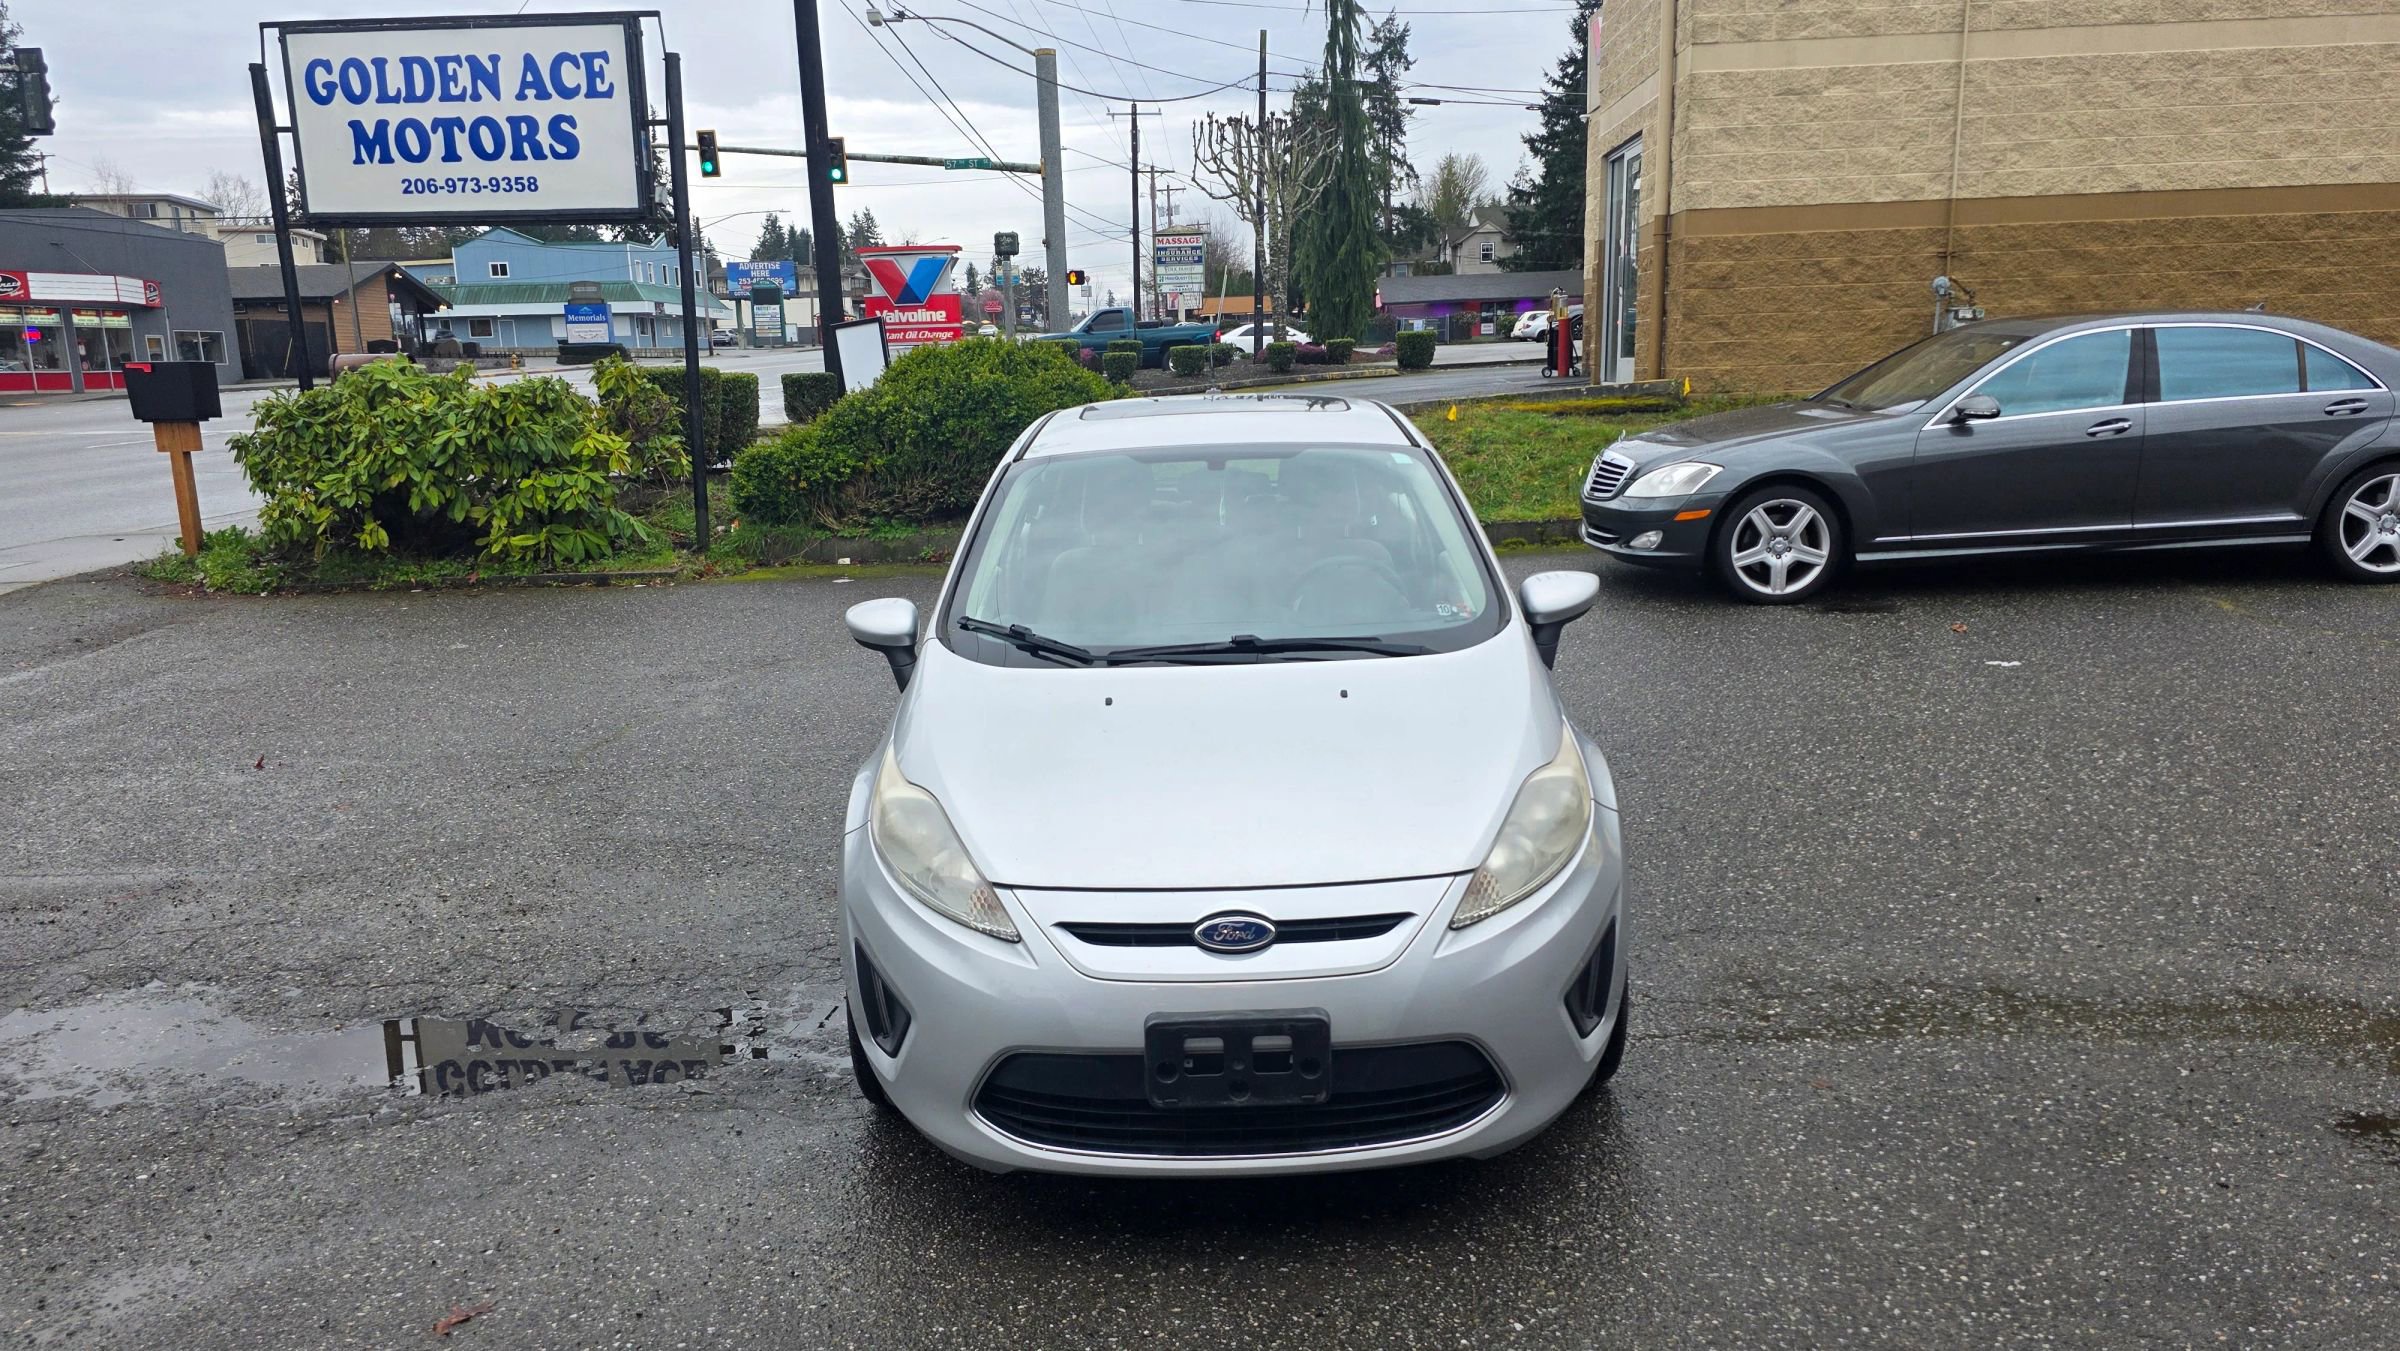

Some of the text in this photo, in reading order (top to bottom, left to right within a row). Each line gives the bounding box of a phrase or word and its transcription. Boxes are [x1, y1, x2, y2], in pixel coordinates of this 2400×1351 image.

[305, 50, 614, 106] GOLDEN ACE
[348, 114, 580, 165] MOTORS
[969, 160, 978, 168] ST
[401, 176, 539, 194] 206-973-9358
[739, 262, 781, 270] ADVERTISE
[875, 309, 947, 322] Valvoline
[886, 330, 954, 339] tant Oil Change
[1214, 922, 1256, 941] Ford
